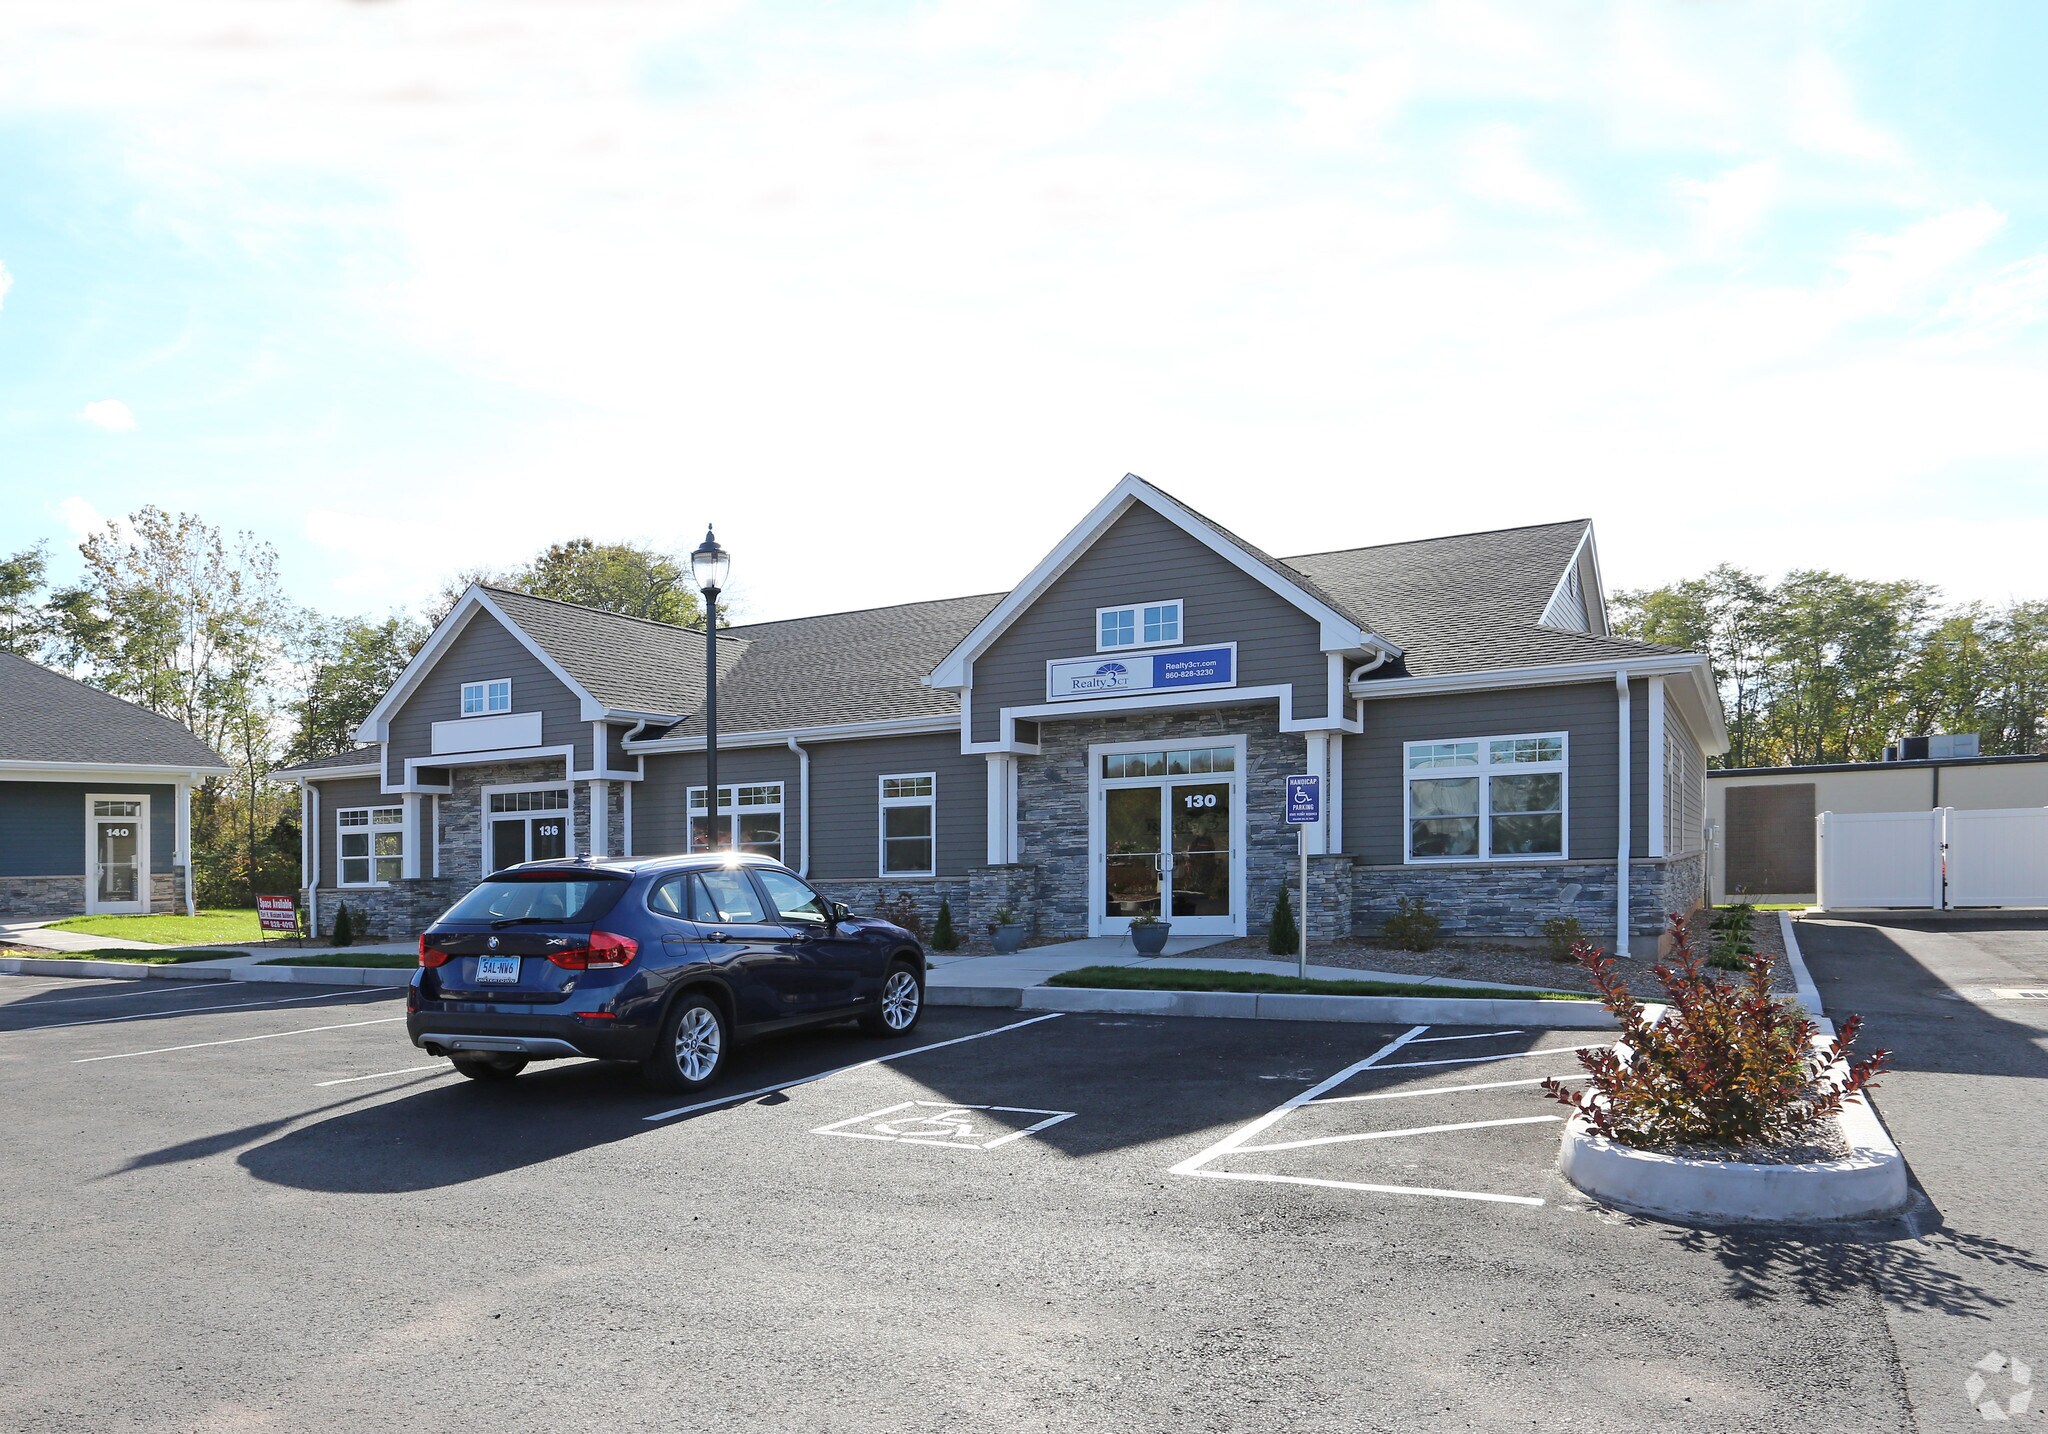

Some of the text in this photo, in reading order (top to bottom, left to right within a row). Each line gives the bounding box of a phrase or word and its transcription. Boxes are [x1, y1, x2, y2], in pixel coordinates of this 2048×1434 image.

[1165, 659, 1217, 671] Realty3CT.com
[1165, 668, 1214, 679] 860-828-3230
[1289, 778, 1317, 786] HANDICAP
[1184, 794, 1217, 808] 130
[106, 828, 129, 837] 140
[539, 825, 559, 836] 136
[259, 898, 292, 910] Space Available
